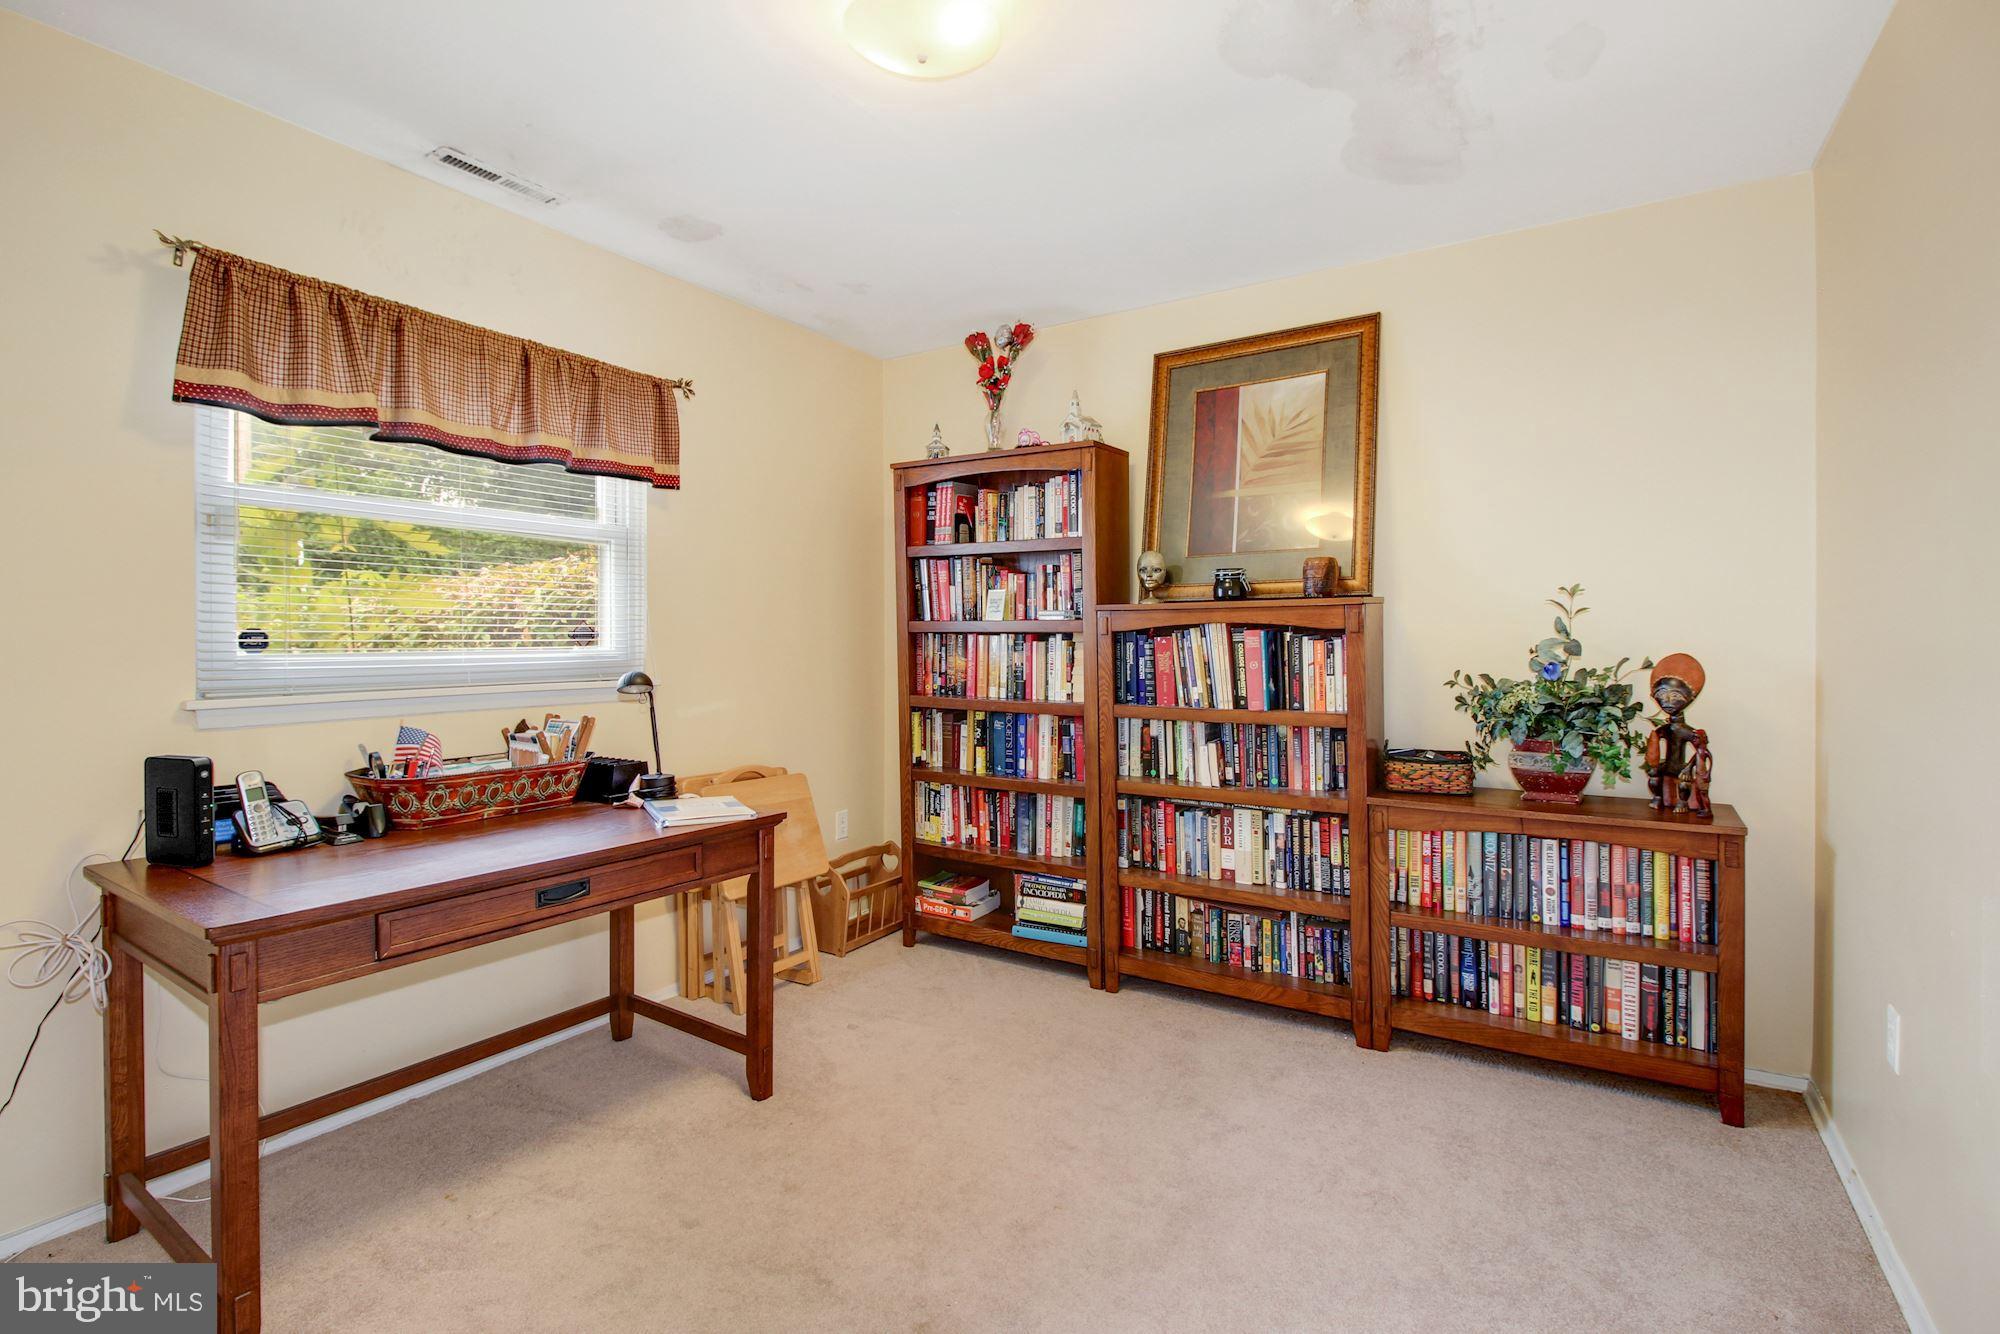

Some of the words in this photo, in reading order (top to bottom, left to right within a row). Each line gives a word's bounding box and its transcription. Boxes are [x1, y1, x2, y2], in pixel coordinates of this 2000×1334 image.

[1224, 816, 1232, 846] FDR
[1292, 818, 1300, 836] STUART
[1292, 838, 1300, 854] WOODS
[1485, 838, 1496, 872] KOONTZ
[1642, 850, 1653, 862] TESS
[1546, 853, 1554, 866] LAST
[1546, 866, 1554, 886] TEMPLAR
[1642, 862, 1654, 892] GERRITSEN
[1682, 866, 1690, 892] STEPHEN
[1023, 887, 1066, 900] ENCYCLOPEDIA
[923, 903, 948, 914] Pre-GED
[1682, 902, 1690, 928] CANNELL
[1571, 955, 1584, 979] RACIAL
[1624, 962, 1636, 989] ICHAEL
[1529, 988, 1538, 1000] THE
[1571, 979, 1584, 1006] MATTER
[1529, 1002, 1538, 1012] KID
[1624, 994, 1636, 1033] CRICHTON
